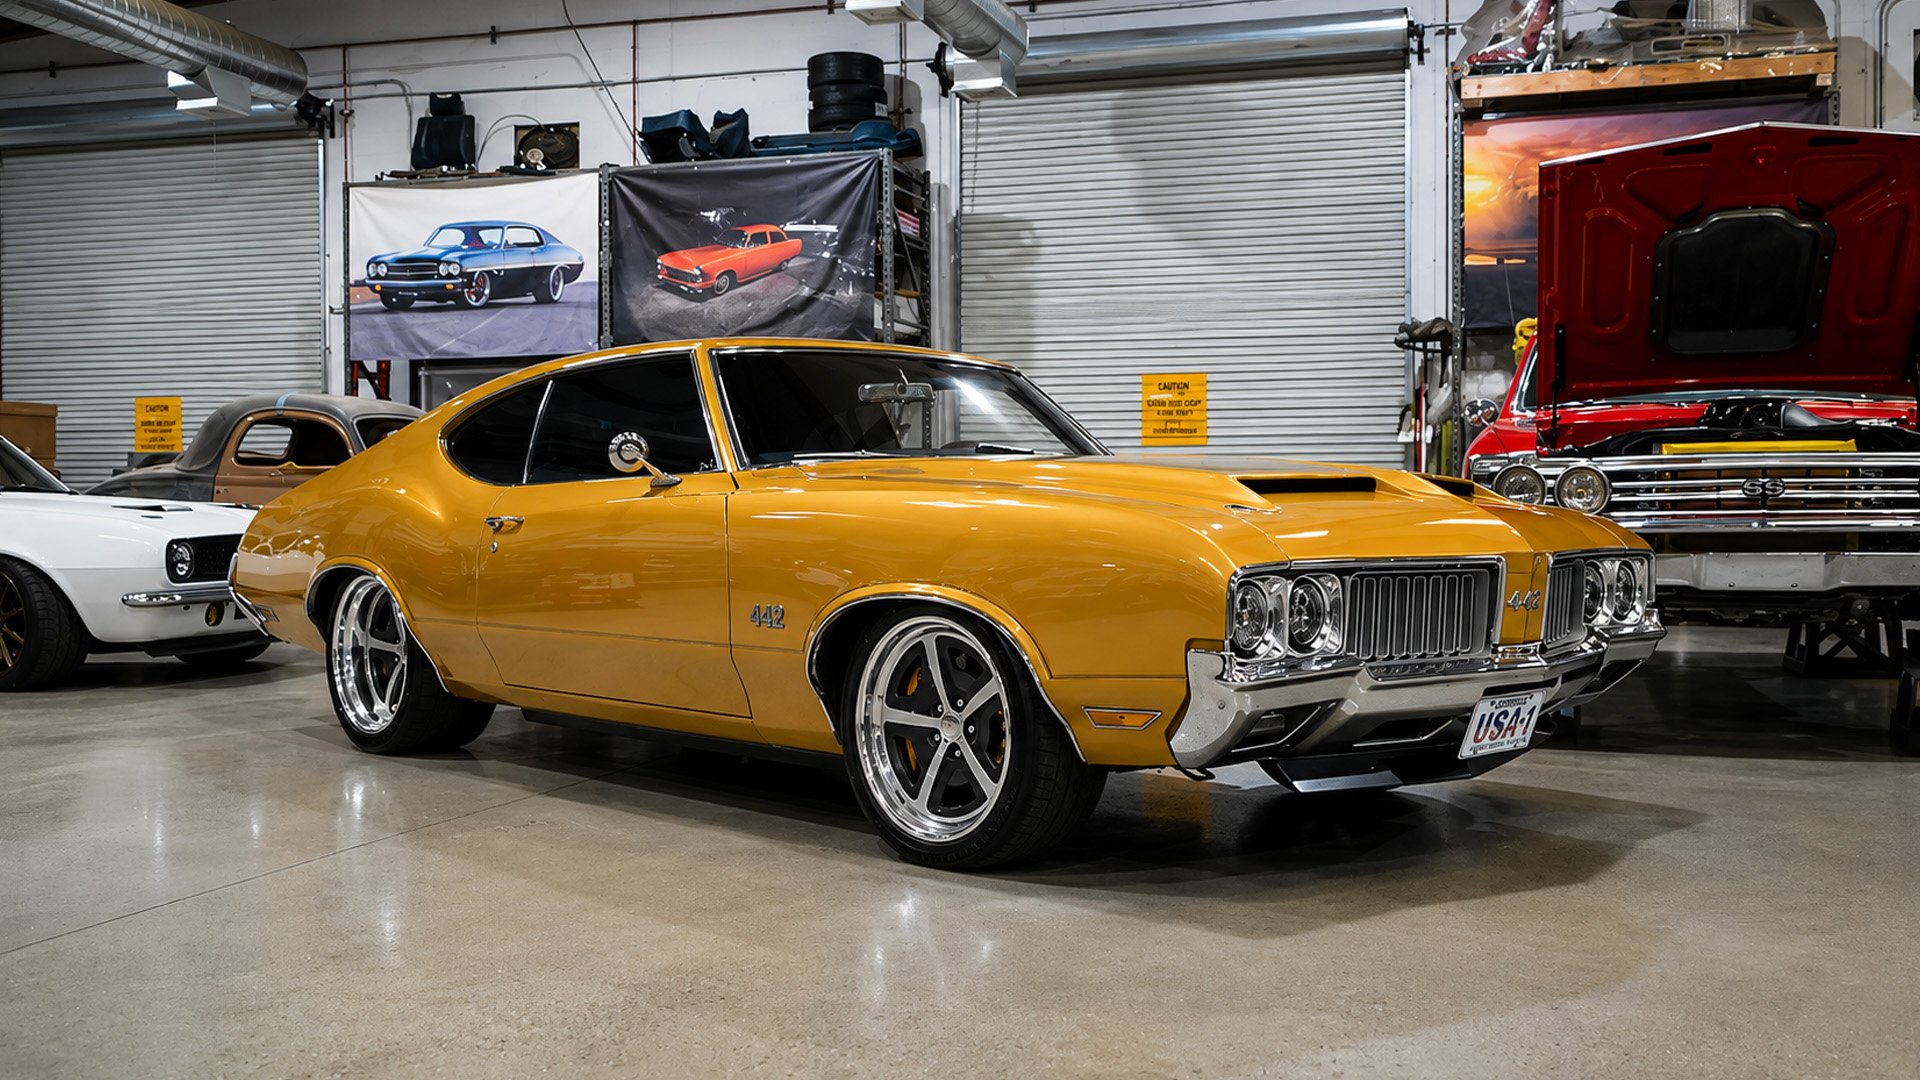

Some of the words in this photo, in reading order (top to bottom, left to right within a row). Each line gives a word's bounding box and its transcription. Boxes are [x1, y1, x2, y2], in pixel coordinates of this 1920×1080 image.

[1158, 381, 1189, 390] CAUTION
[1743, 481, 1783, 495] SS
[750, 603, 785, 629] 442
